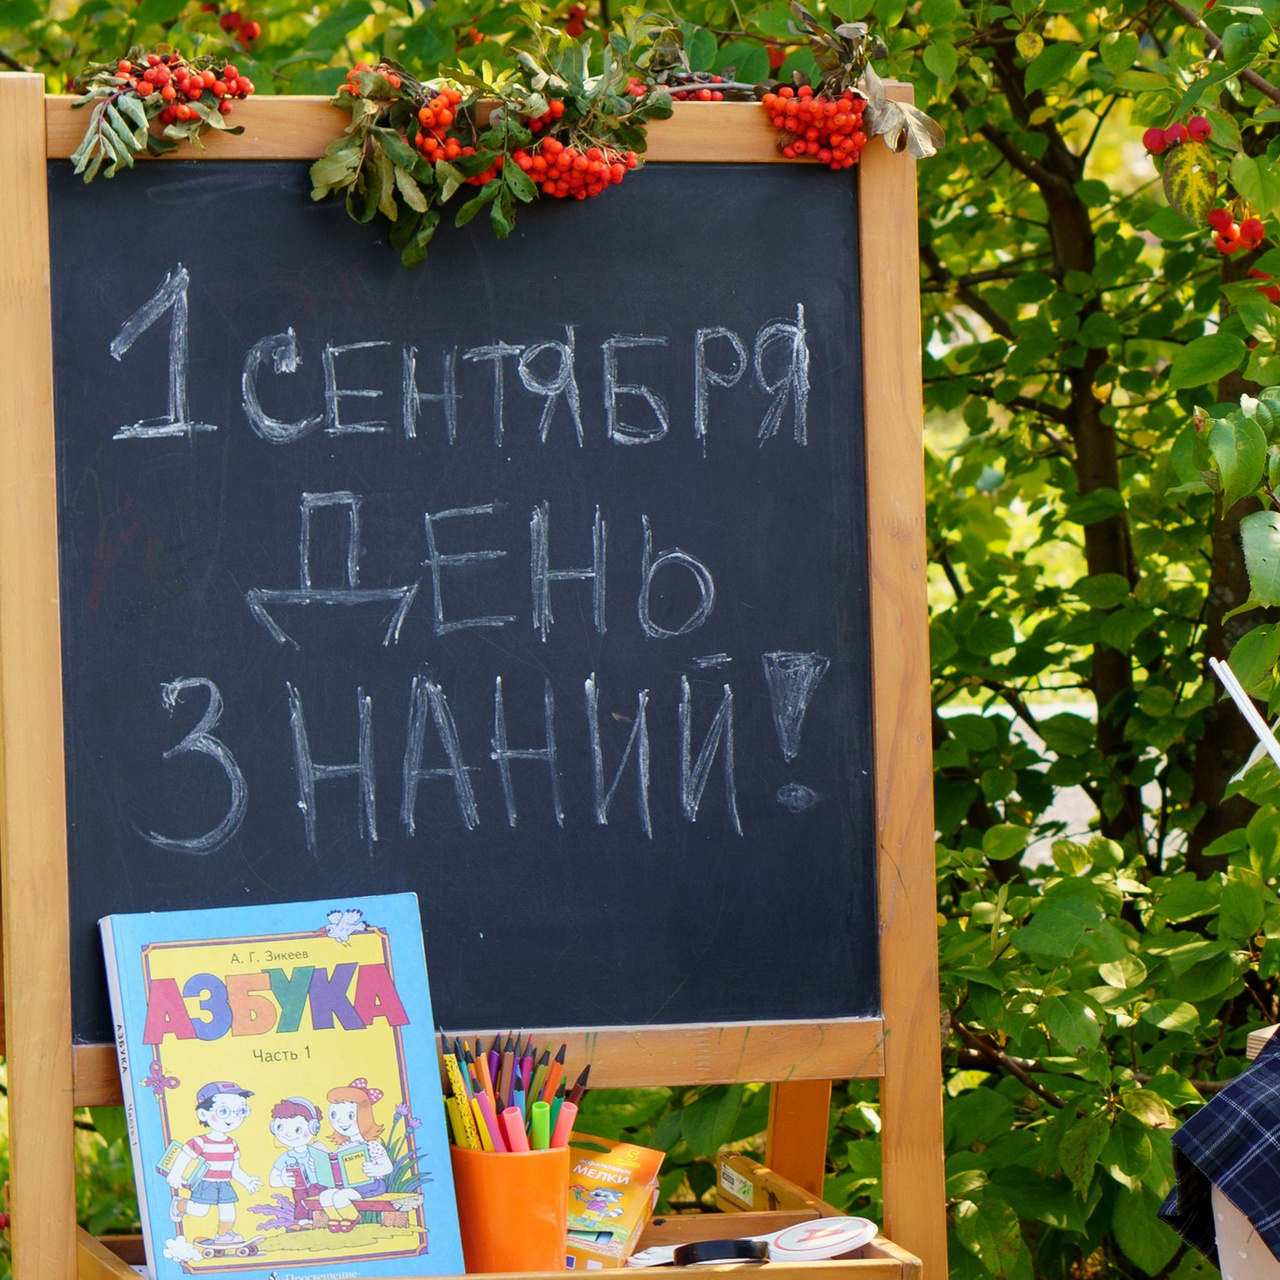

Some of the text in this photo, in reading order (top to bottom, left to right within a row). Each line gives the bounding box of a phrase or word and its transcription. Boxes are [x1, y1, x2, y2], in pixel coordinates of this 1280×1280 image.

[109, 263, 811, 457] 1 СЕНТЯБРЯ
[246, 490, 716, 649] ДЕНЬ
[265, 948, 309, 962] Зикеев
[142, 962, 411, 1046] АЗБУКА
[116, 1023, 129, 1074] АЗБУКА
[252, 1045, 312, 1063] Часть 1
[625, 1149, 640, 1160] 5
[572, 1164, 630, 1185] МЕЛКИ
